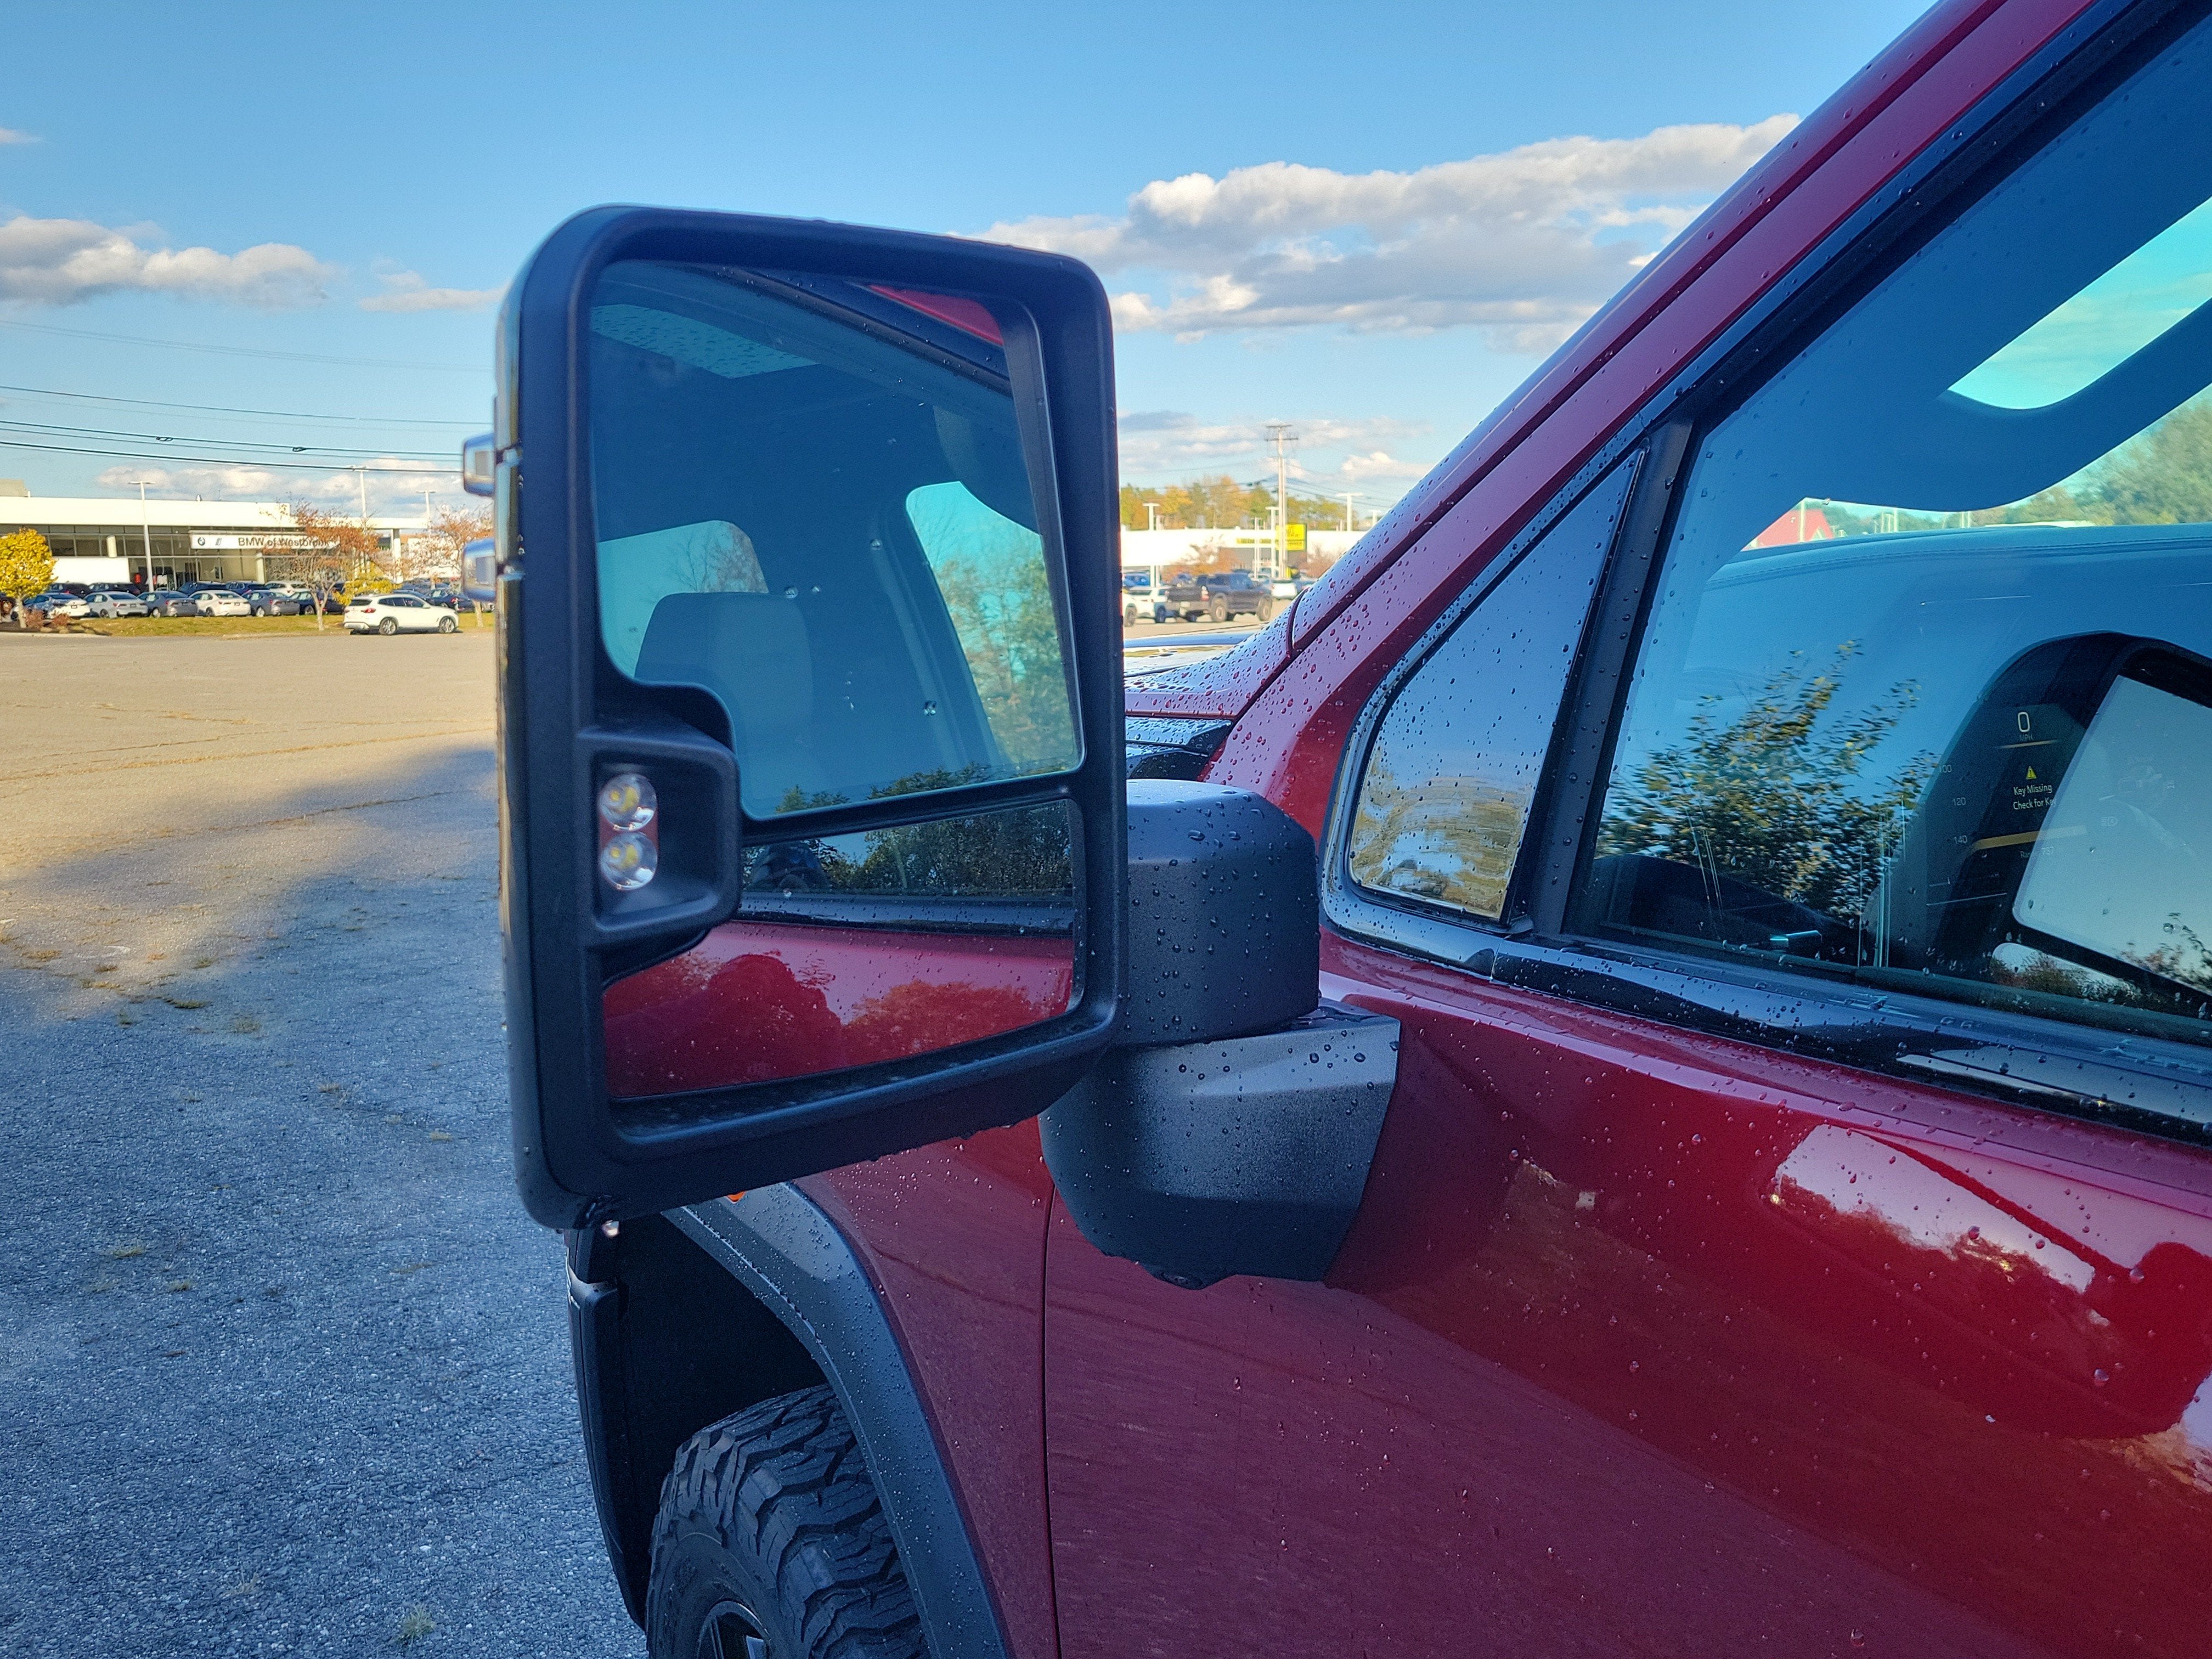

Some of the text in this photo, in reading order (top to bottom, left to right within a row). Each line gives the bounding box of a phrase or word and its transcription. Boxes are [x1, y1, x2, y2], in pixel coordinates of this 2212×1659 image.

[238, 538, 264, 546] BMW
[2017, 712, 2030, 732] 0
[2013, 783, 2052, 797] Key Missing
[1953, 797, 1966, 806] 120
[2013, 799, 2033, 810] Check
[2034, 798, 2044, 807] for
[1954, 835, 1967, 844] 140
